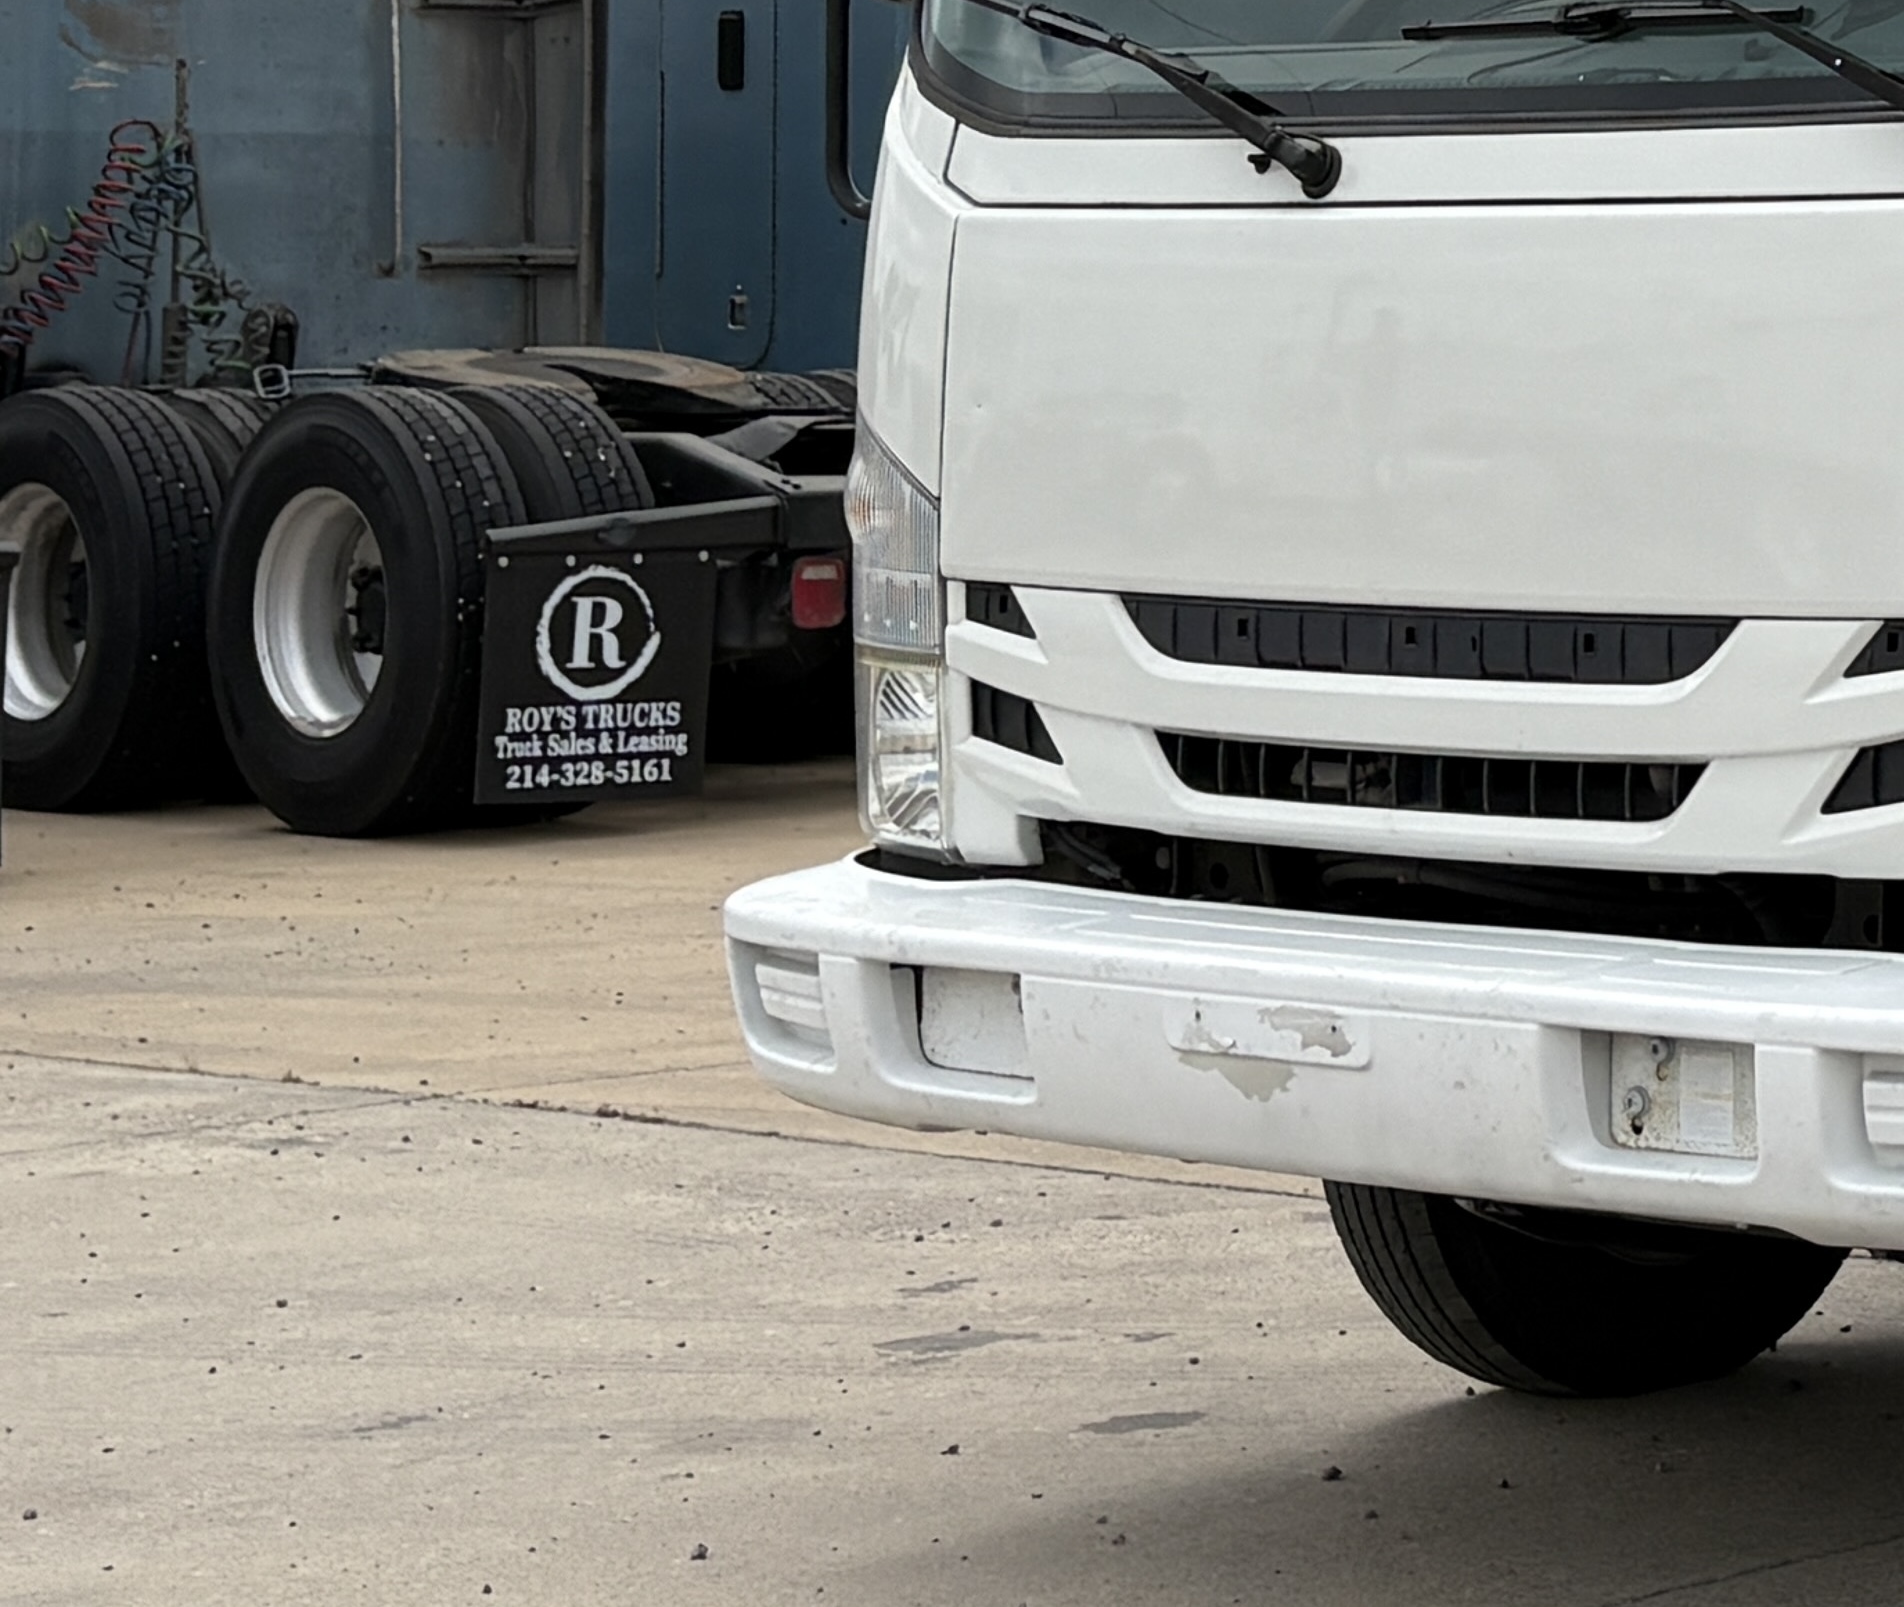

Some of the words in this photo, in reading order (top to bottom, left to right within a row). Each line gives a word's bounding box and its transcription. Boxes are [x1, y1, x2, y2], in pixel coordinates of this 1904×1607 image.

[565, 595, 627, 670] R
[505, 704, 577, 734] ROY'S
[582, 701, 682, 730] TRUCKS
[494, 734, 543, 759] Truck
[547, 730, 596, 757] Sales
[597, 732, 613, 755] &
[617, 727, 689, 756] Leasing
[505, 758, 673, 790] 214-328-5161
